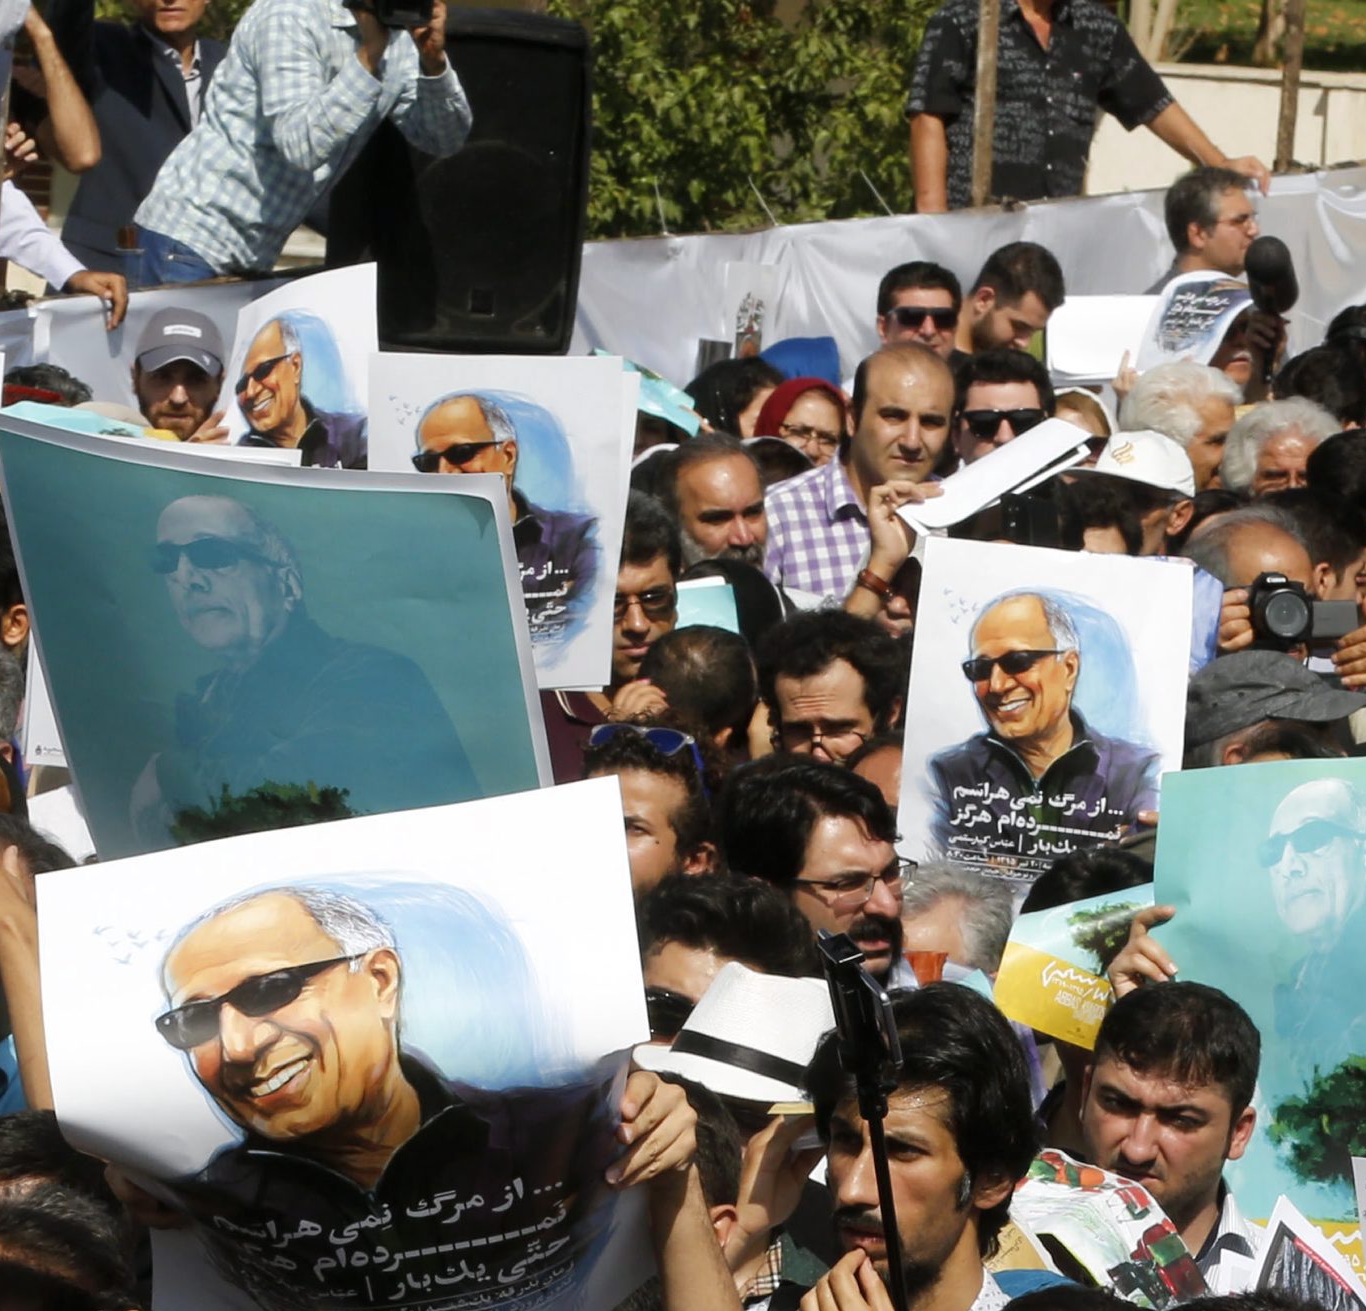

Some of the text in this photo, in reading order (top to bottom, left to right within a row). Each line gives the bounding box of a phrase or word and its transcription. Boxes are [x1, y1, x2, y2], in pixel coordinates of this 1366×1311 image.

[950, 803, 992, 827] هرگز
[1048, 793, 1087, 815] مرگ
[1087, 797, 1107, 817] از
[492, 1177, 524, 1212] از
[405, 1190, 485, 1224] مرگ
